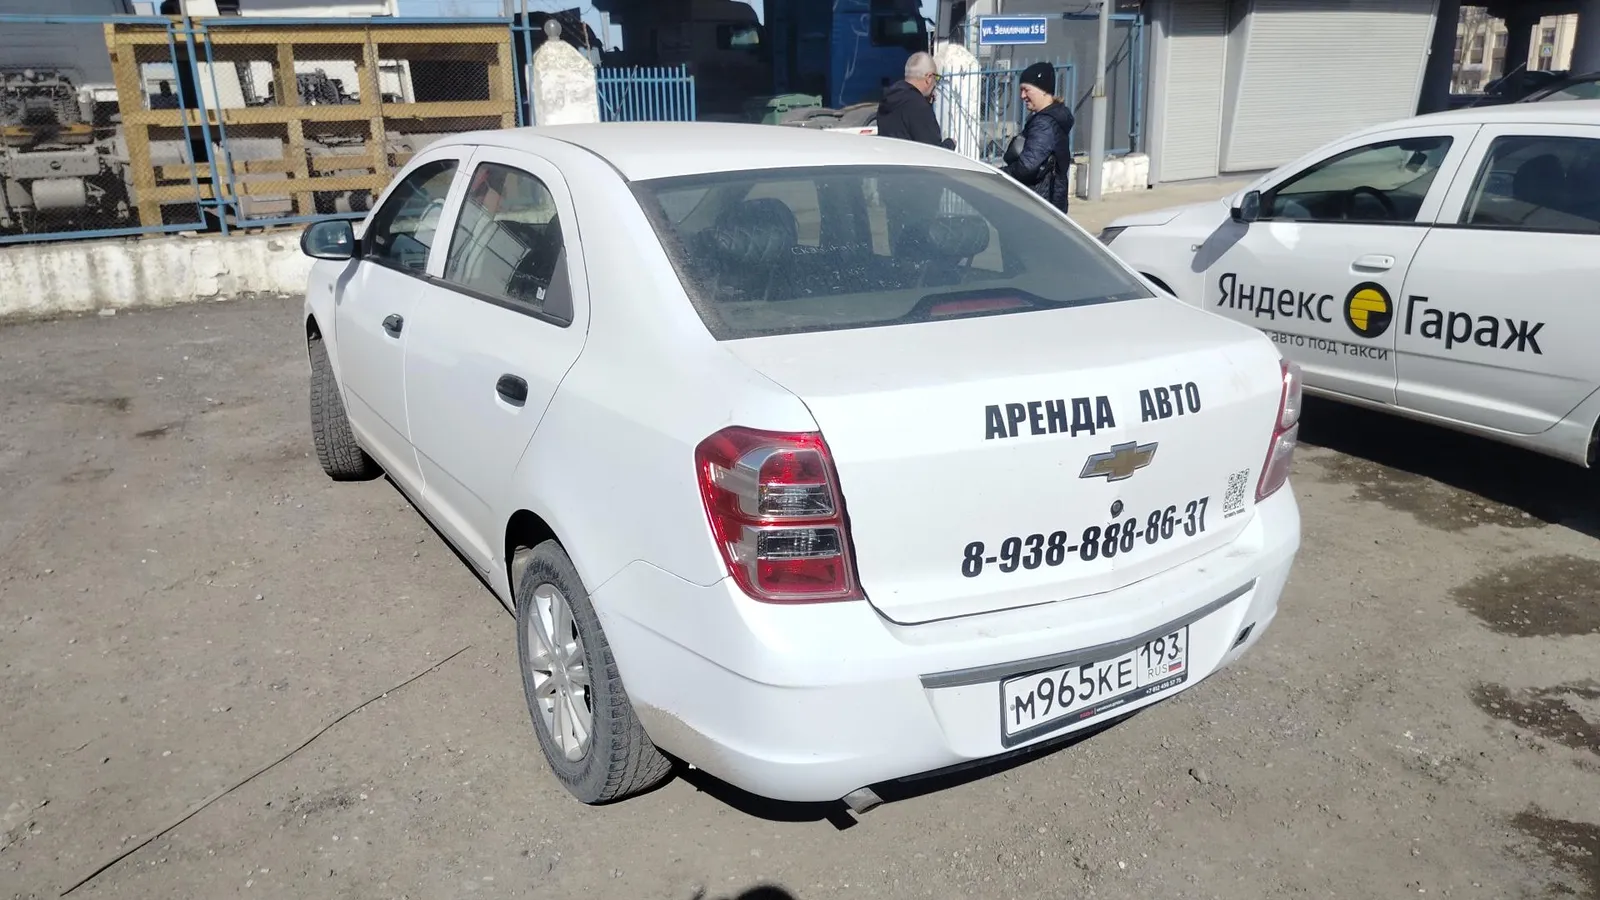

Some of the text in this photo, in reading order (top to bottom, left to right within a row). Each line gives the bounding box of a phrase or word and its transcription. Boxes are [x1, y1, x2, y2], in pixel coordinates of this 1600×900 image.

[1217, 272, 1546, 354] Яндекс Гараж
[1271, 333, 1304, 347] авто
[1308, 337, 1338, 354] под
[1343, 343, 1388, 361] такси
[985, 381, 1201, 440] АРЕНДА АВТО
[961, 496, 1209, 578] 8-938-888-86-37
[1140, 632, 1179, 668] 193
[1148, 664, 1167, 680] RUS
